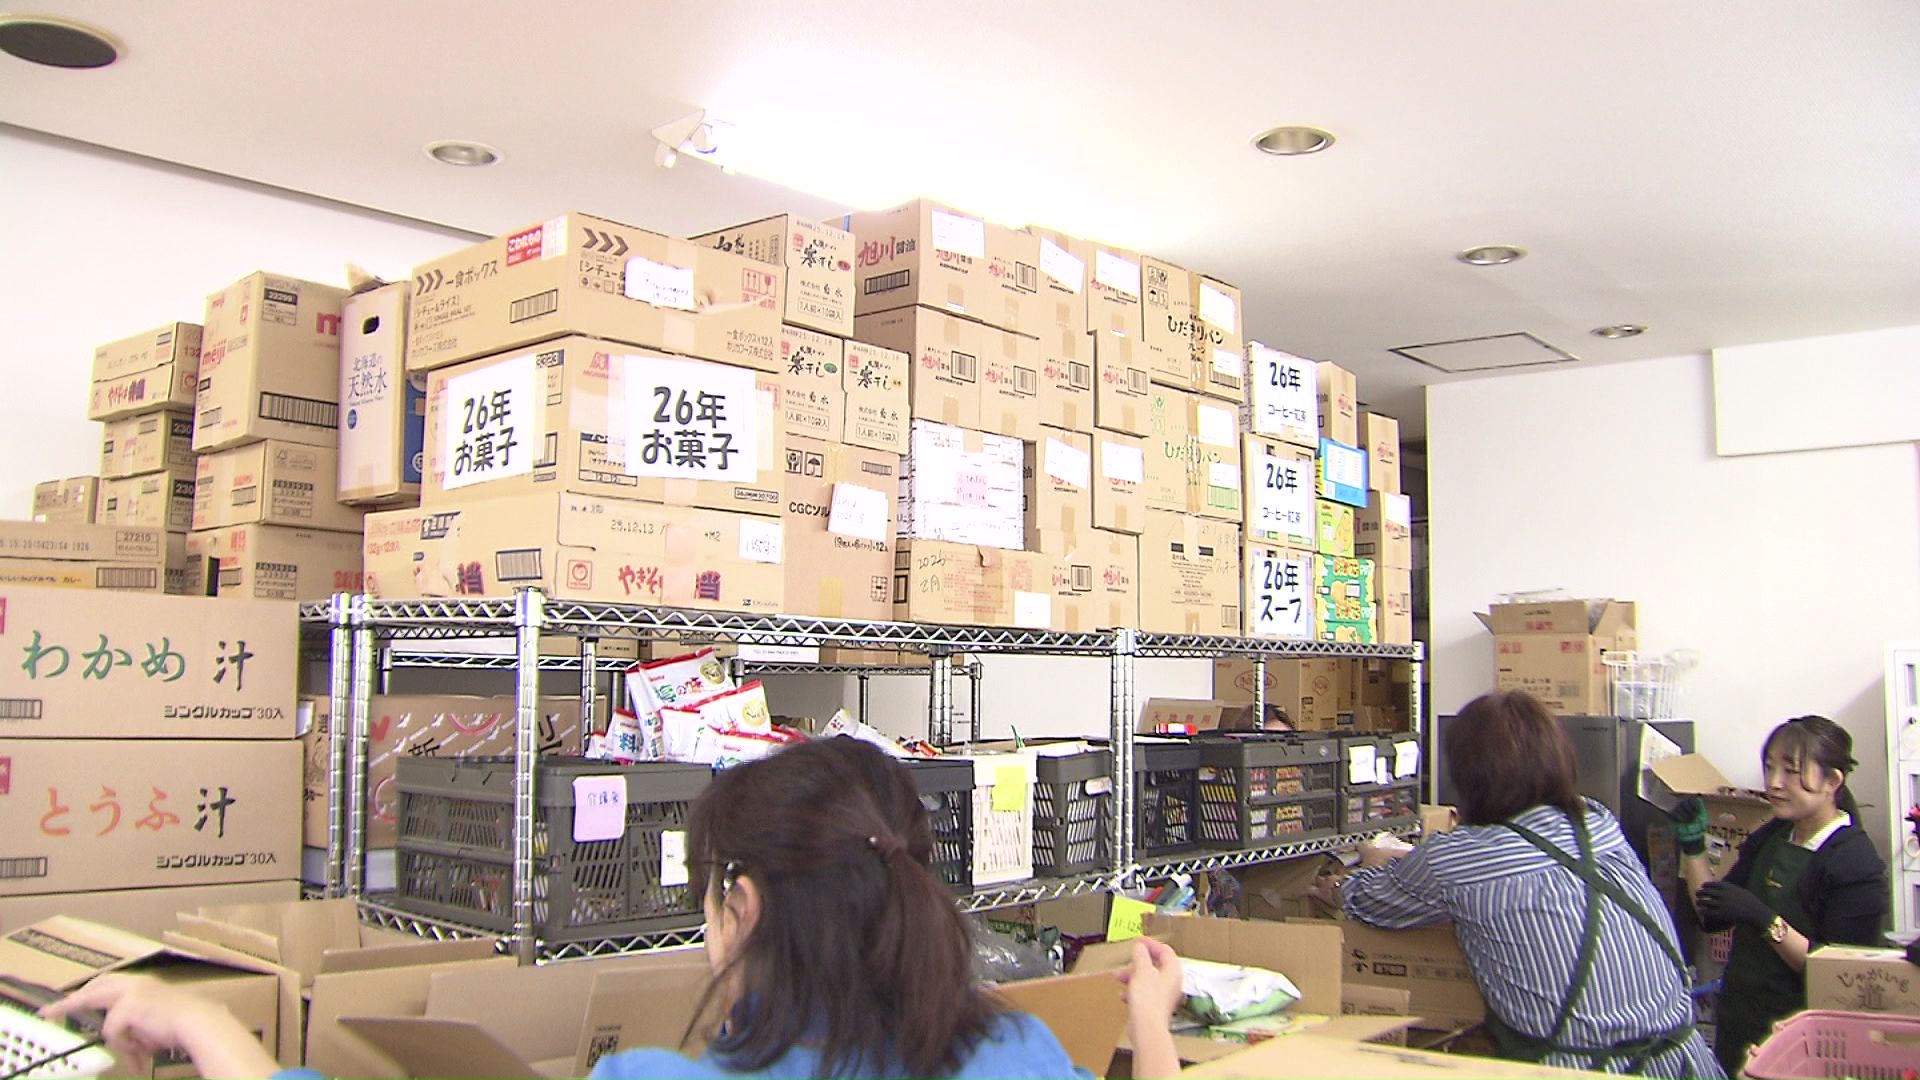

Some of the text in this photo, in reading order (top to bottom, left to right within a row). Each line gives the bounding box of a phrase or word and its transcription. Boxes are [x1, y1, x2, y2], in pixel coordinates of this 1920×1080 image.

[801, 243, 837, 272] 寒干し
[858, 236, 916, 268] 旭川醤油
[446, 260, 499, 288] 一食ボックス
[1167, 314, 1224, 345] ひだまりパン
[787, 351, 825, 378] 寒干し
[857, 365, 892, 391] 寒干し
[1269, 361, 1302, 393] 26年
[347, 368, 388, 400] 天然水
[464, 388, 513, 435] 26年
[653, 386, 727, 429] 26年
[454, 426, 518, 477] お菓子
[640, 428, 739, 471] お菓子
[1265, 462, 1298, 494] 26年
[1263, 559, 1300, 593] 26年
[38, 785, 237, 838] とうふ汁
